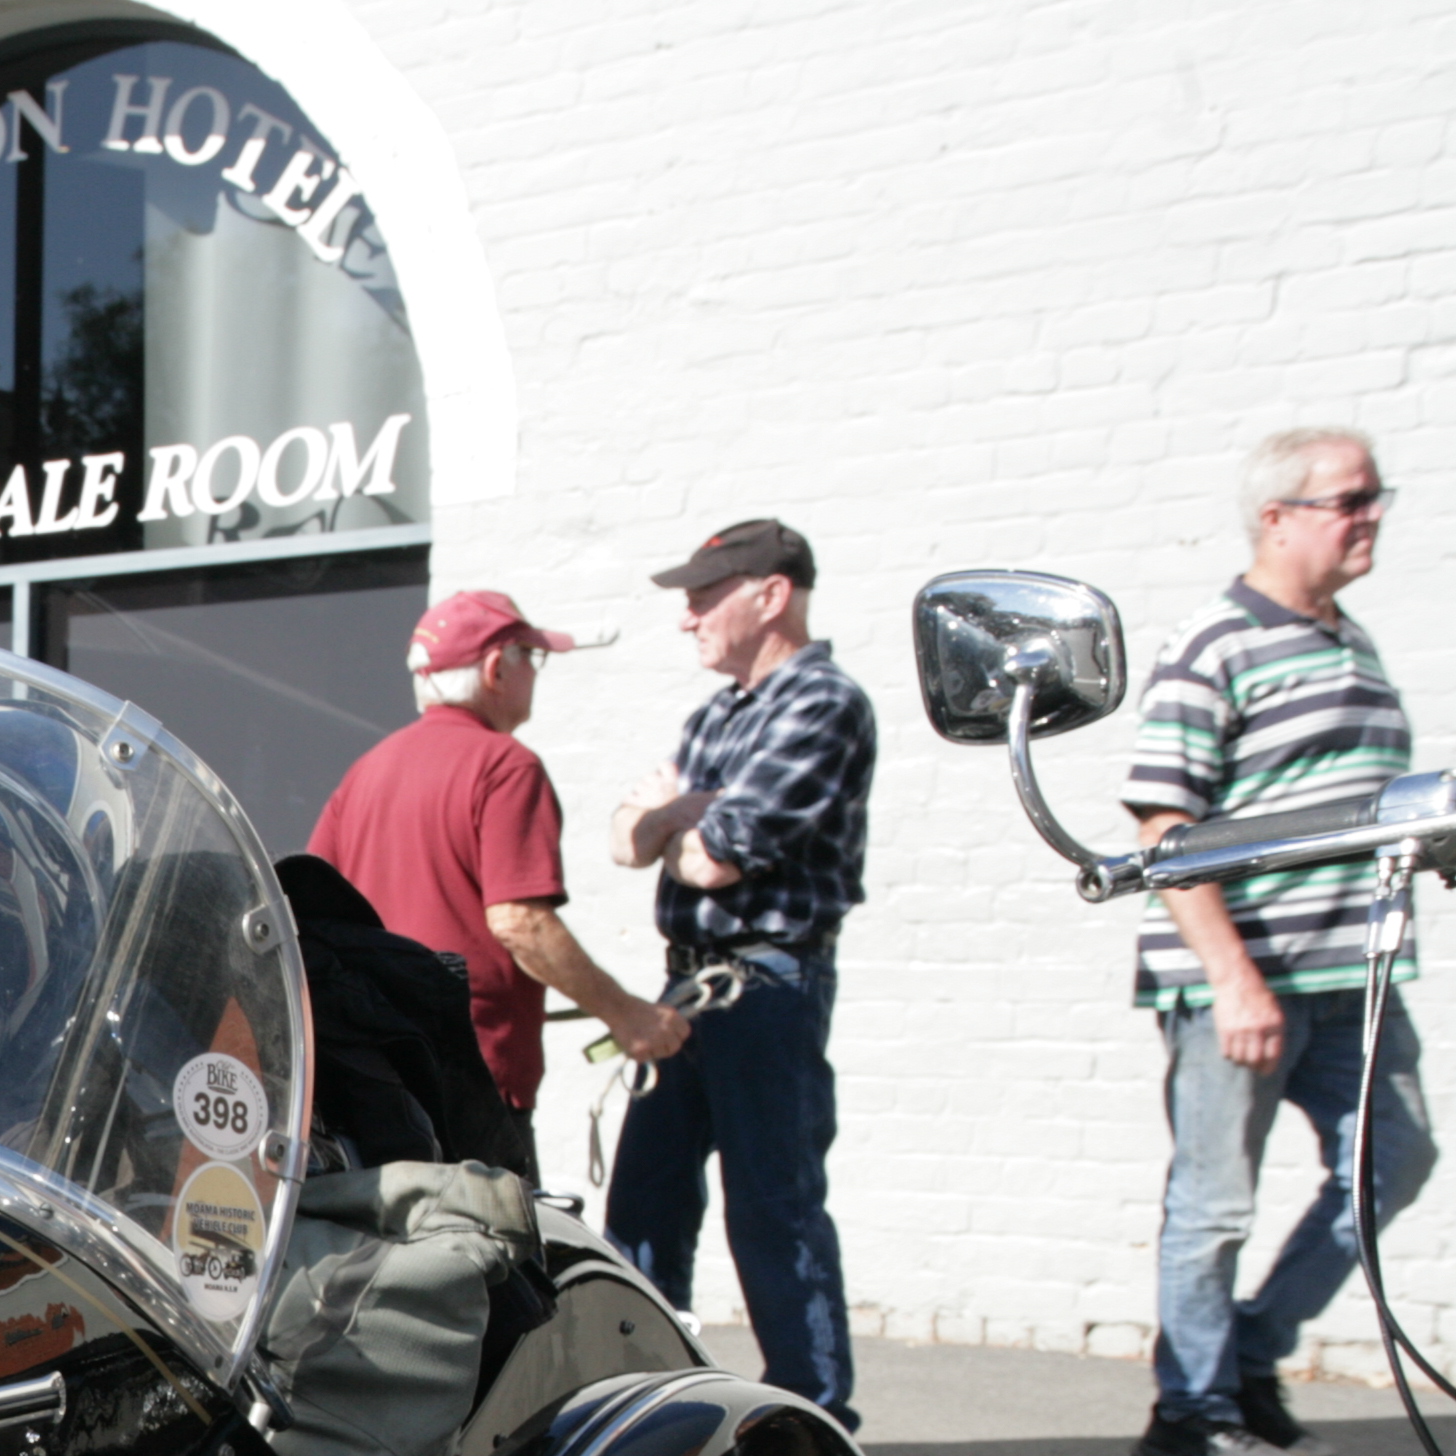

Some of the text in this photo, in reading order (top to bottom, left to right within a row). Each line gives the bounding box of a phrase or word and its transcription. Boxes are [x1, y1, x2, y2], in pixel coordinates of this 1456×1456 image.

[103, 74, 364, 263] HOTEL
[136, 413, 412, 522] ROOM
[207, 1063, 238, 1092] BIKE
[193, 1091, 248, 1134] 398
[185, 1203, 256, 1220] MOAMA HISTORIC
